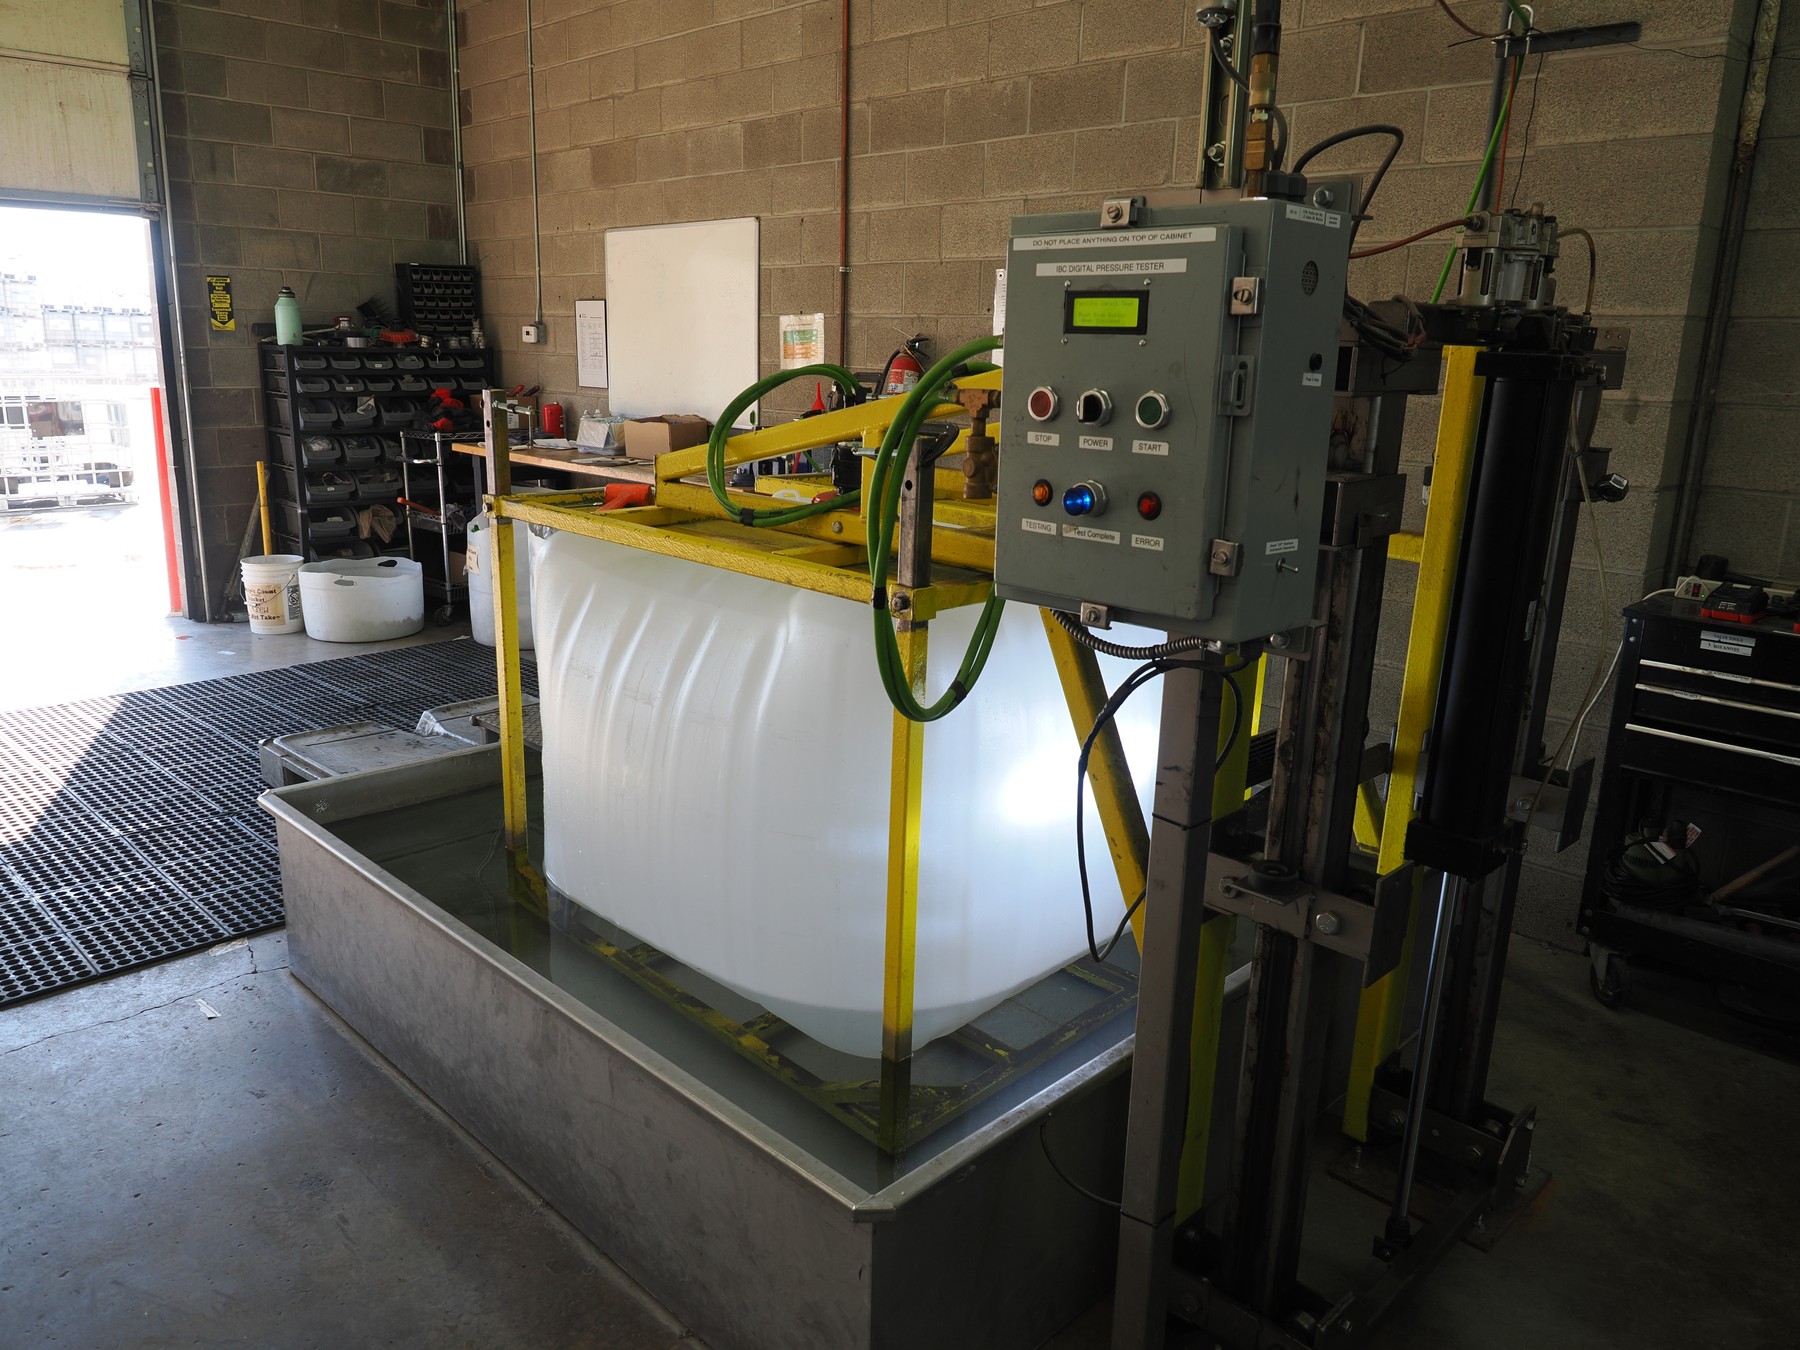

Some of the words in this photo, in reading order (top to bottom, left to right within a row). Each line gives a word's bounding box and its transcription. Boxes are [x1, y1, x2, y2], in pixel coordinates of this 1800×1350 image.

[1059, 237, 1080, 245] PLACE
[1082, 236, 1117, 244] ANYTHING
[1119, 235, 1130, 243] ON
[1148, 233, 1159, 241] OF
[1160, 232, 1193, 240] CABINET
[1068, 264, 1095, 273] DIGITAL
[1096, 263, 1134, 272] PRESSURE
[1135, 262, 1165, 271] TESTER
[1034, 434, 1053, 443] STOP
[1083, 438, 1109, 447] POWER
[1138, 442, 1162, 452] START
[1025, 521, 1052, 532] TESTING
[1073, 527, 1086, 537] Test
[1087, 530, 1115, 542] Complete
[1135, 537, 1160, 547] ERROR
